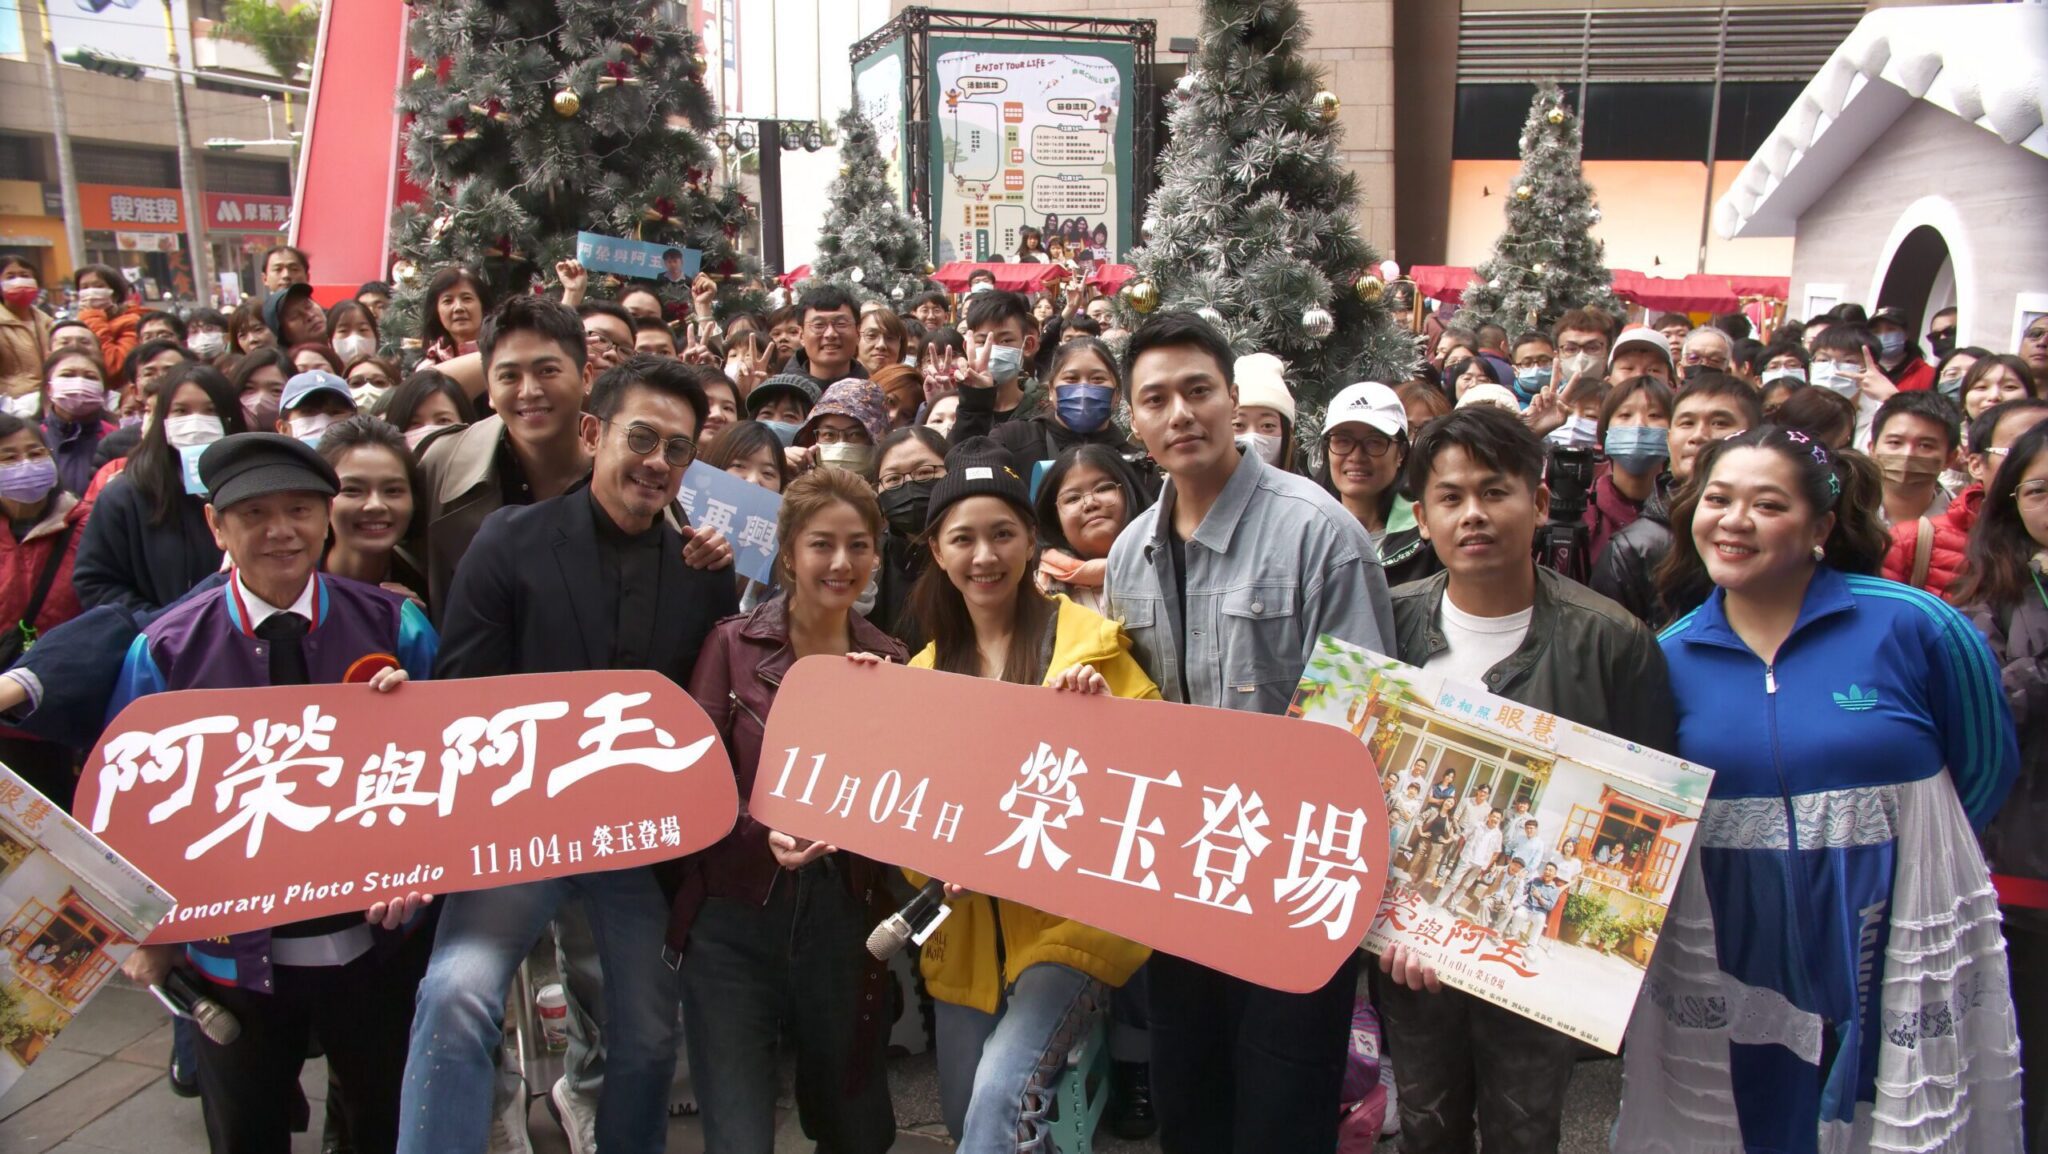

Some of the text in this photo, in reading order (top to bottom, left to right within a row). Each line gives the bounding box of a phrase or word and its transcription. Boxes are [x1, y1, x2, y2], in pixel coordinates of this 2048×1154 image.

[975, 59, 1045, 72] ENJOY YOUR LIFE
[92, 691, 716, 861] 阿榮與阿玉
[591, 815, 681, 858] 榮玉登場
[984, 741, 1369, 941] 榮玉登場
[284, 881, 354, 905] Photo
[362, 863, 444, 893] Studio
